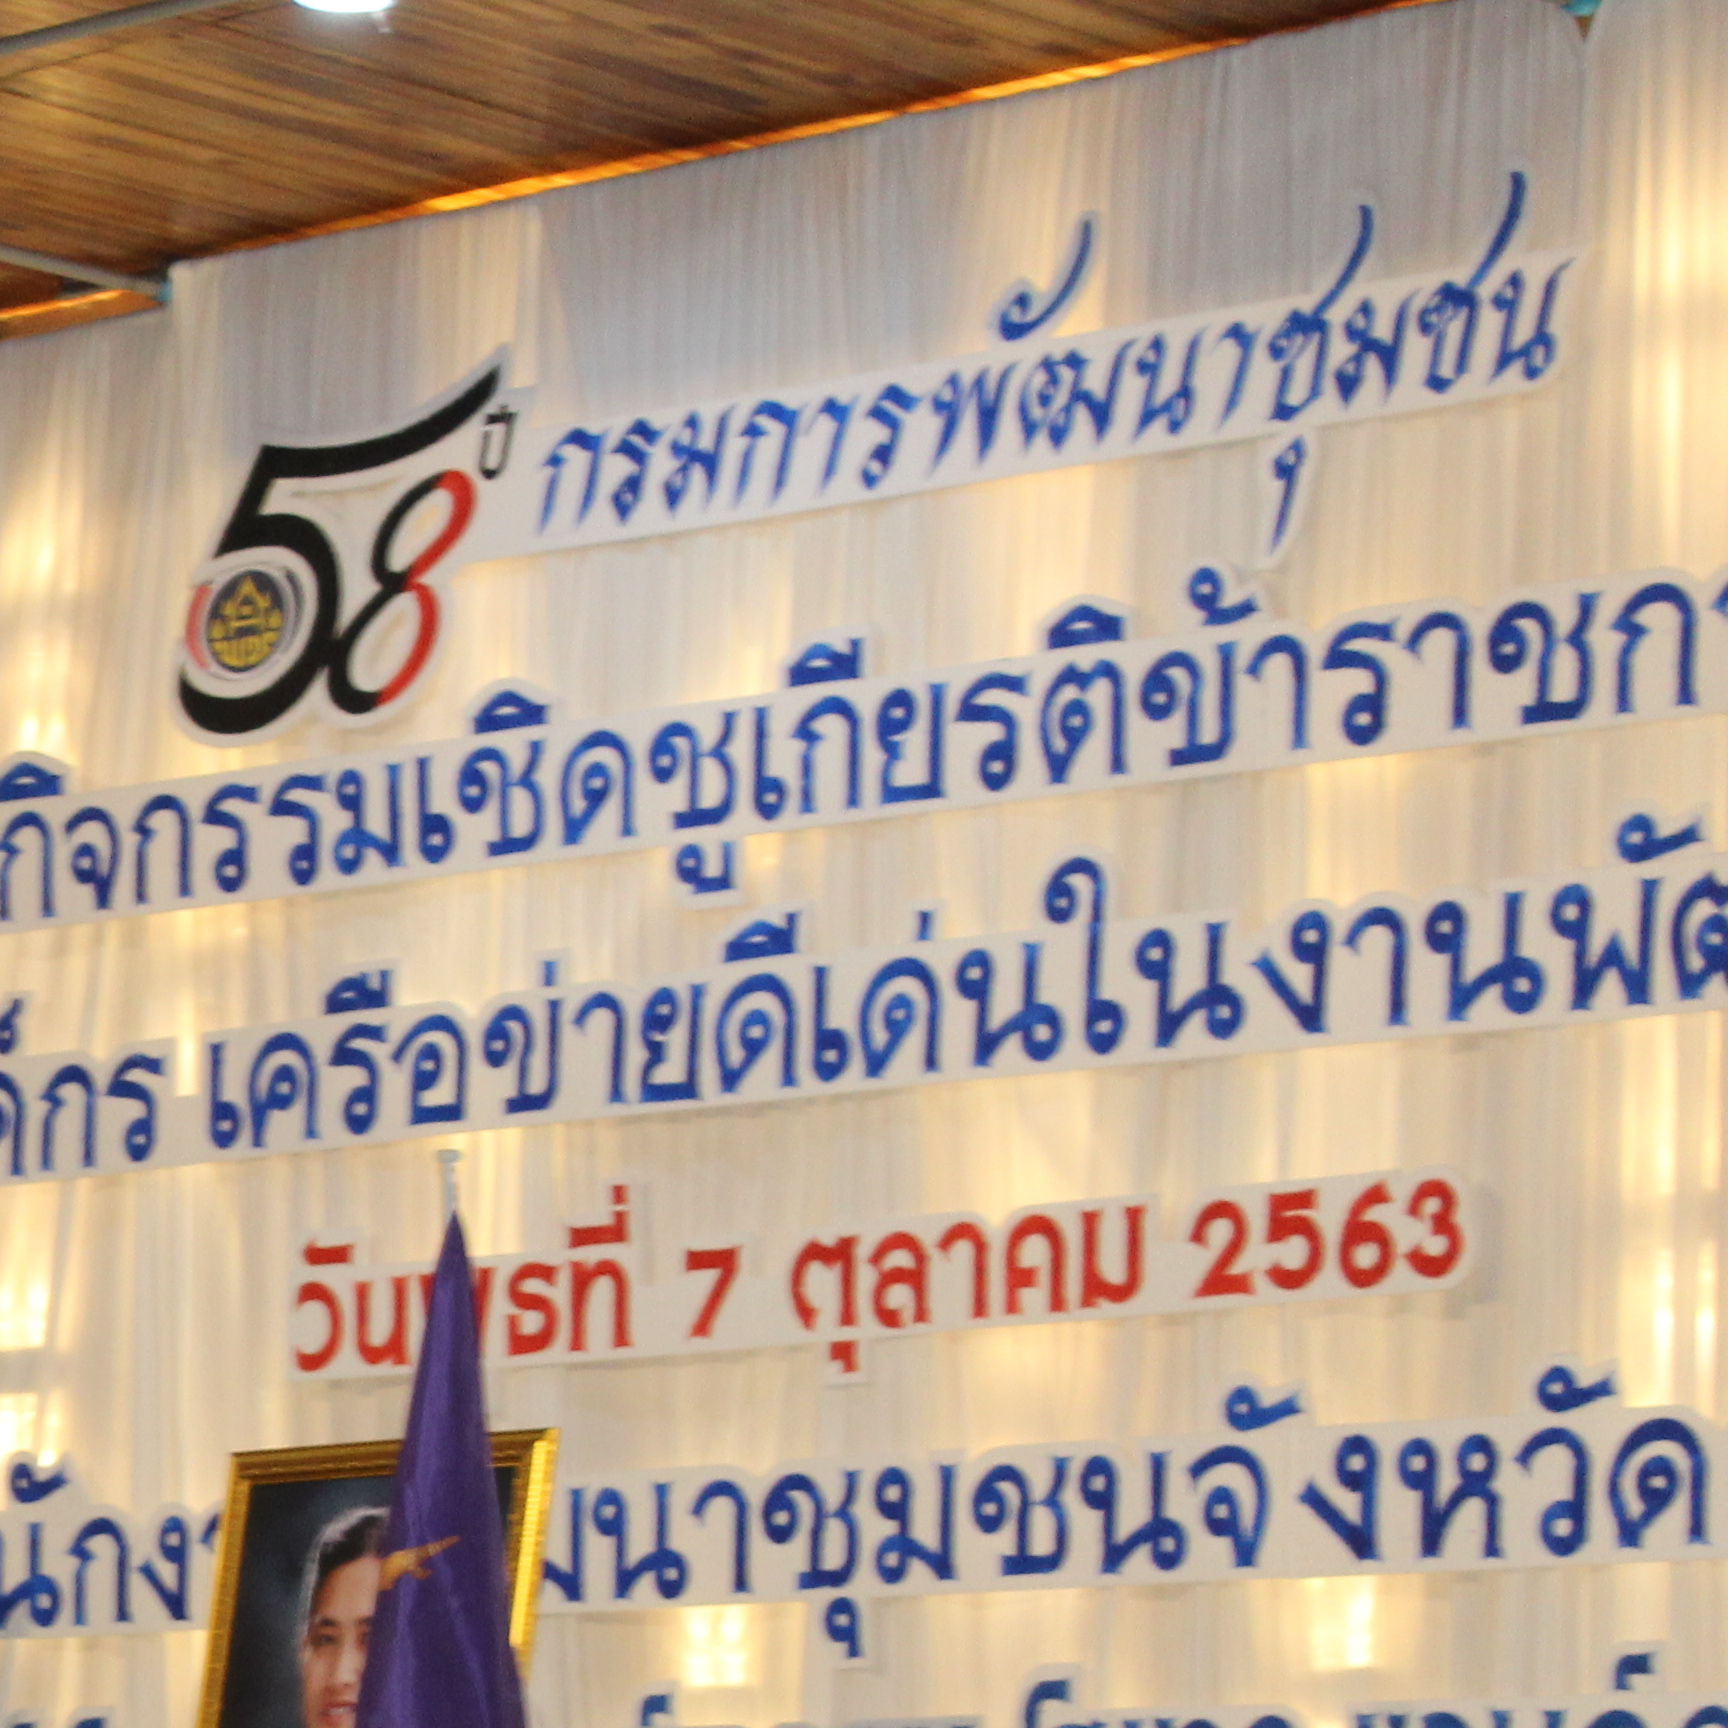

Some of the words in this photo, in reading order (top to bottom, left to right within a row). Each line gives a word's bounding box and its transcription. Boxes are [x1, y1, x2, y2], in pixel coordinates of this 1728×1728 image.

[539, 172, 1569, 550] กรมการพัฒนาชุมชน
[178, 365, 501, 735] 58
[684, 1247, 740, 1338] 7
[790, 1205, 1148, 1374] ตุลาคม
[1189, 1178, 1466, 1300] 2563
